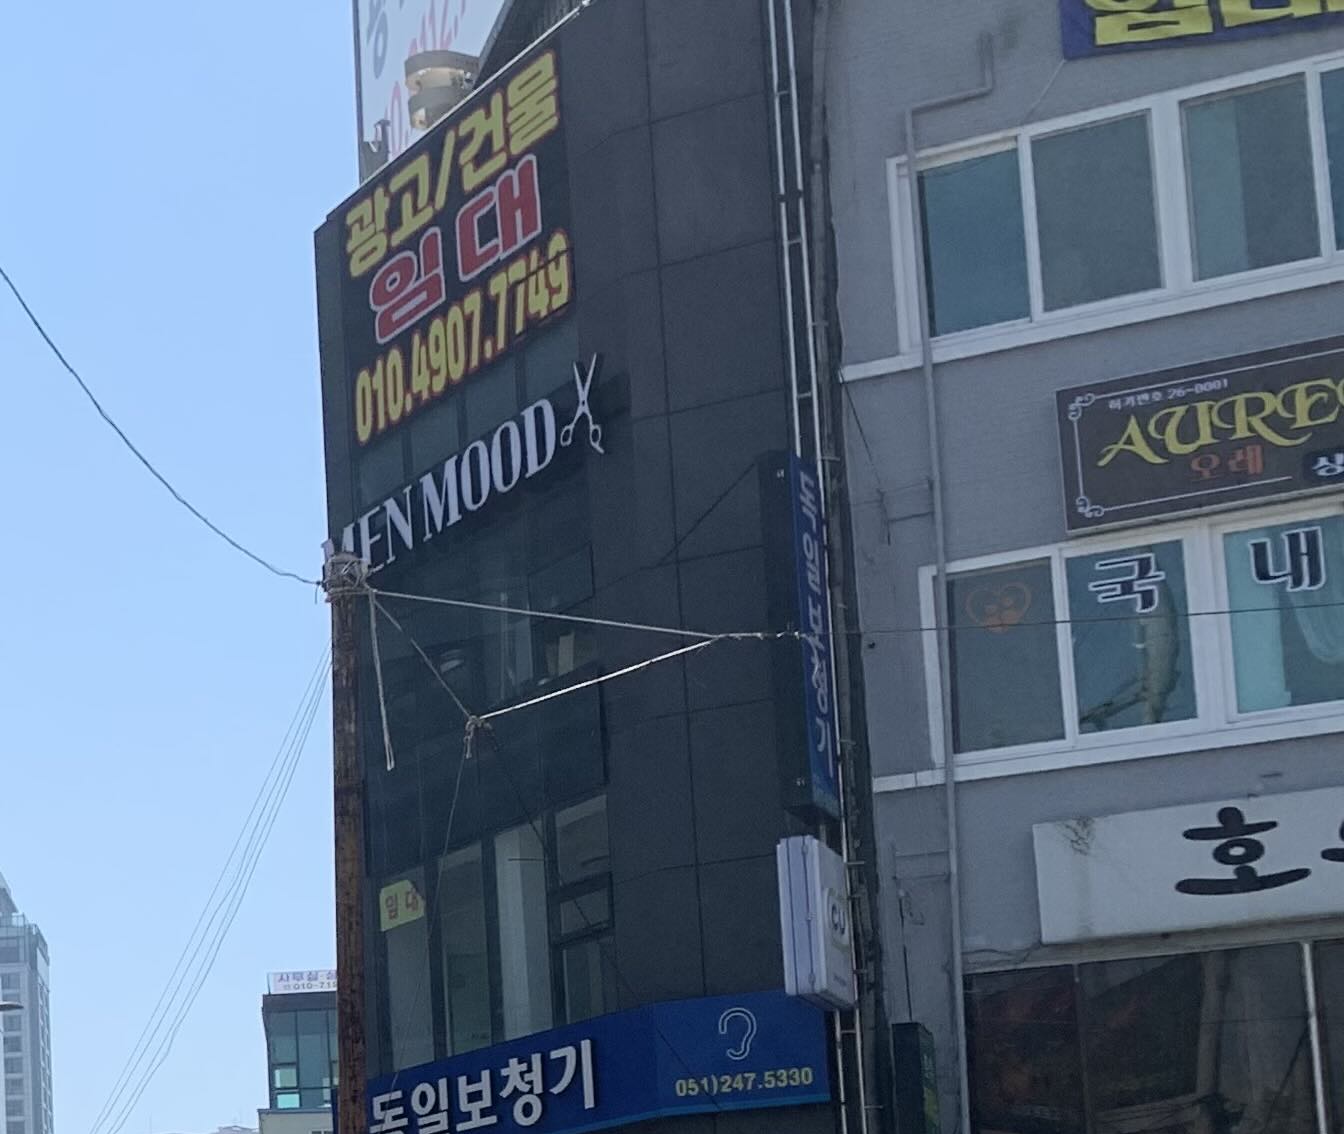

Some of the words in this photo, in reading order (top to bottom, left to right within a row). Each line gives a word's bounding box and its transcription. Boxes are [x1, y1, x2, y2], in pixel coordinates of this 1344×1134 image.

[346, 50, 559, 279] 광고/건물
[369, 153, 542, 345] 임대
[355, 230, 571, 446] 010.4907.7749
[422, 400, 556, 543] MOOD
[1097, 378, 1344, 467] AURE
[675, 1067, 813, 1098] 051)247.5330
